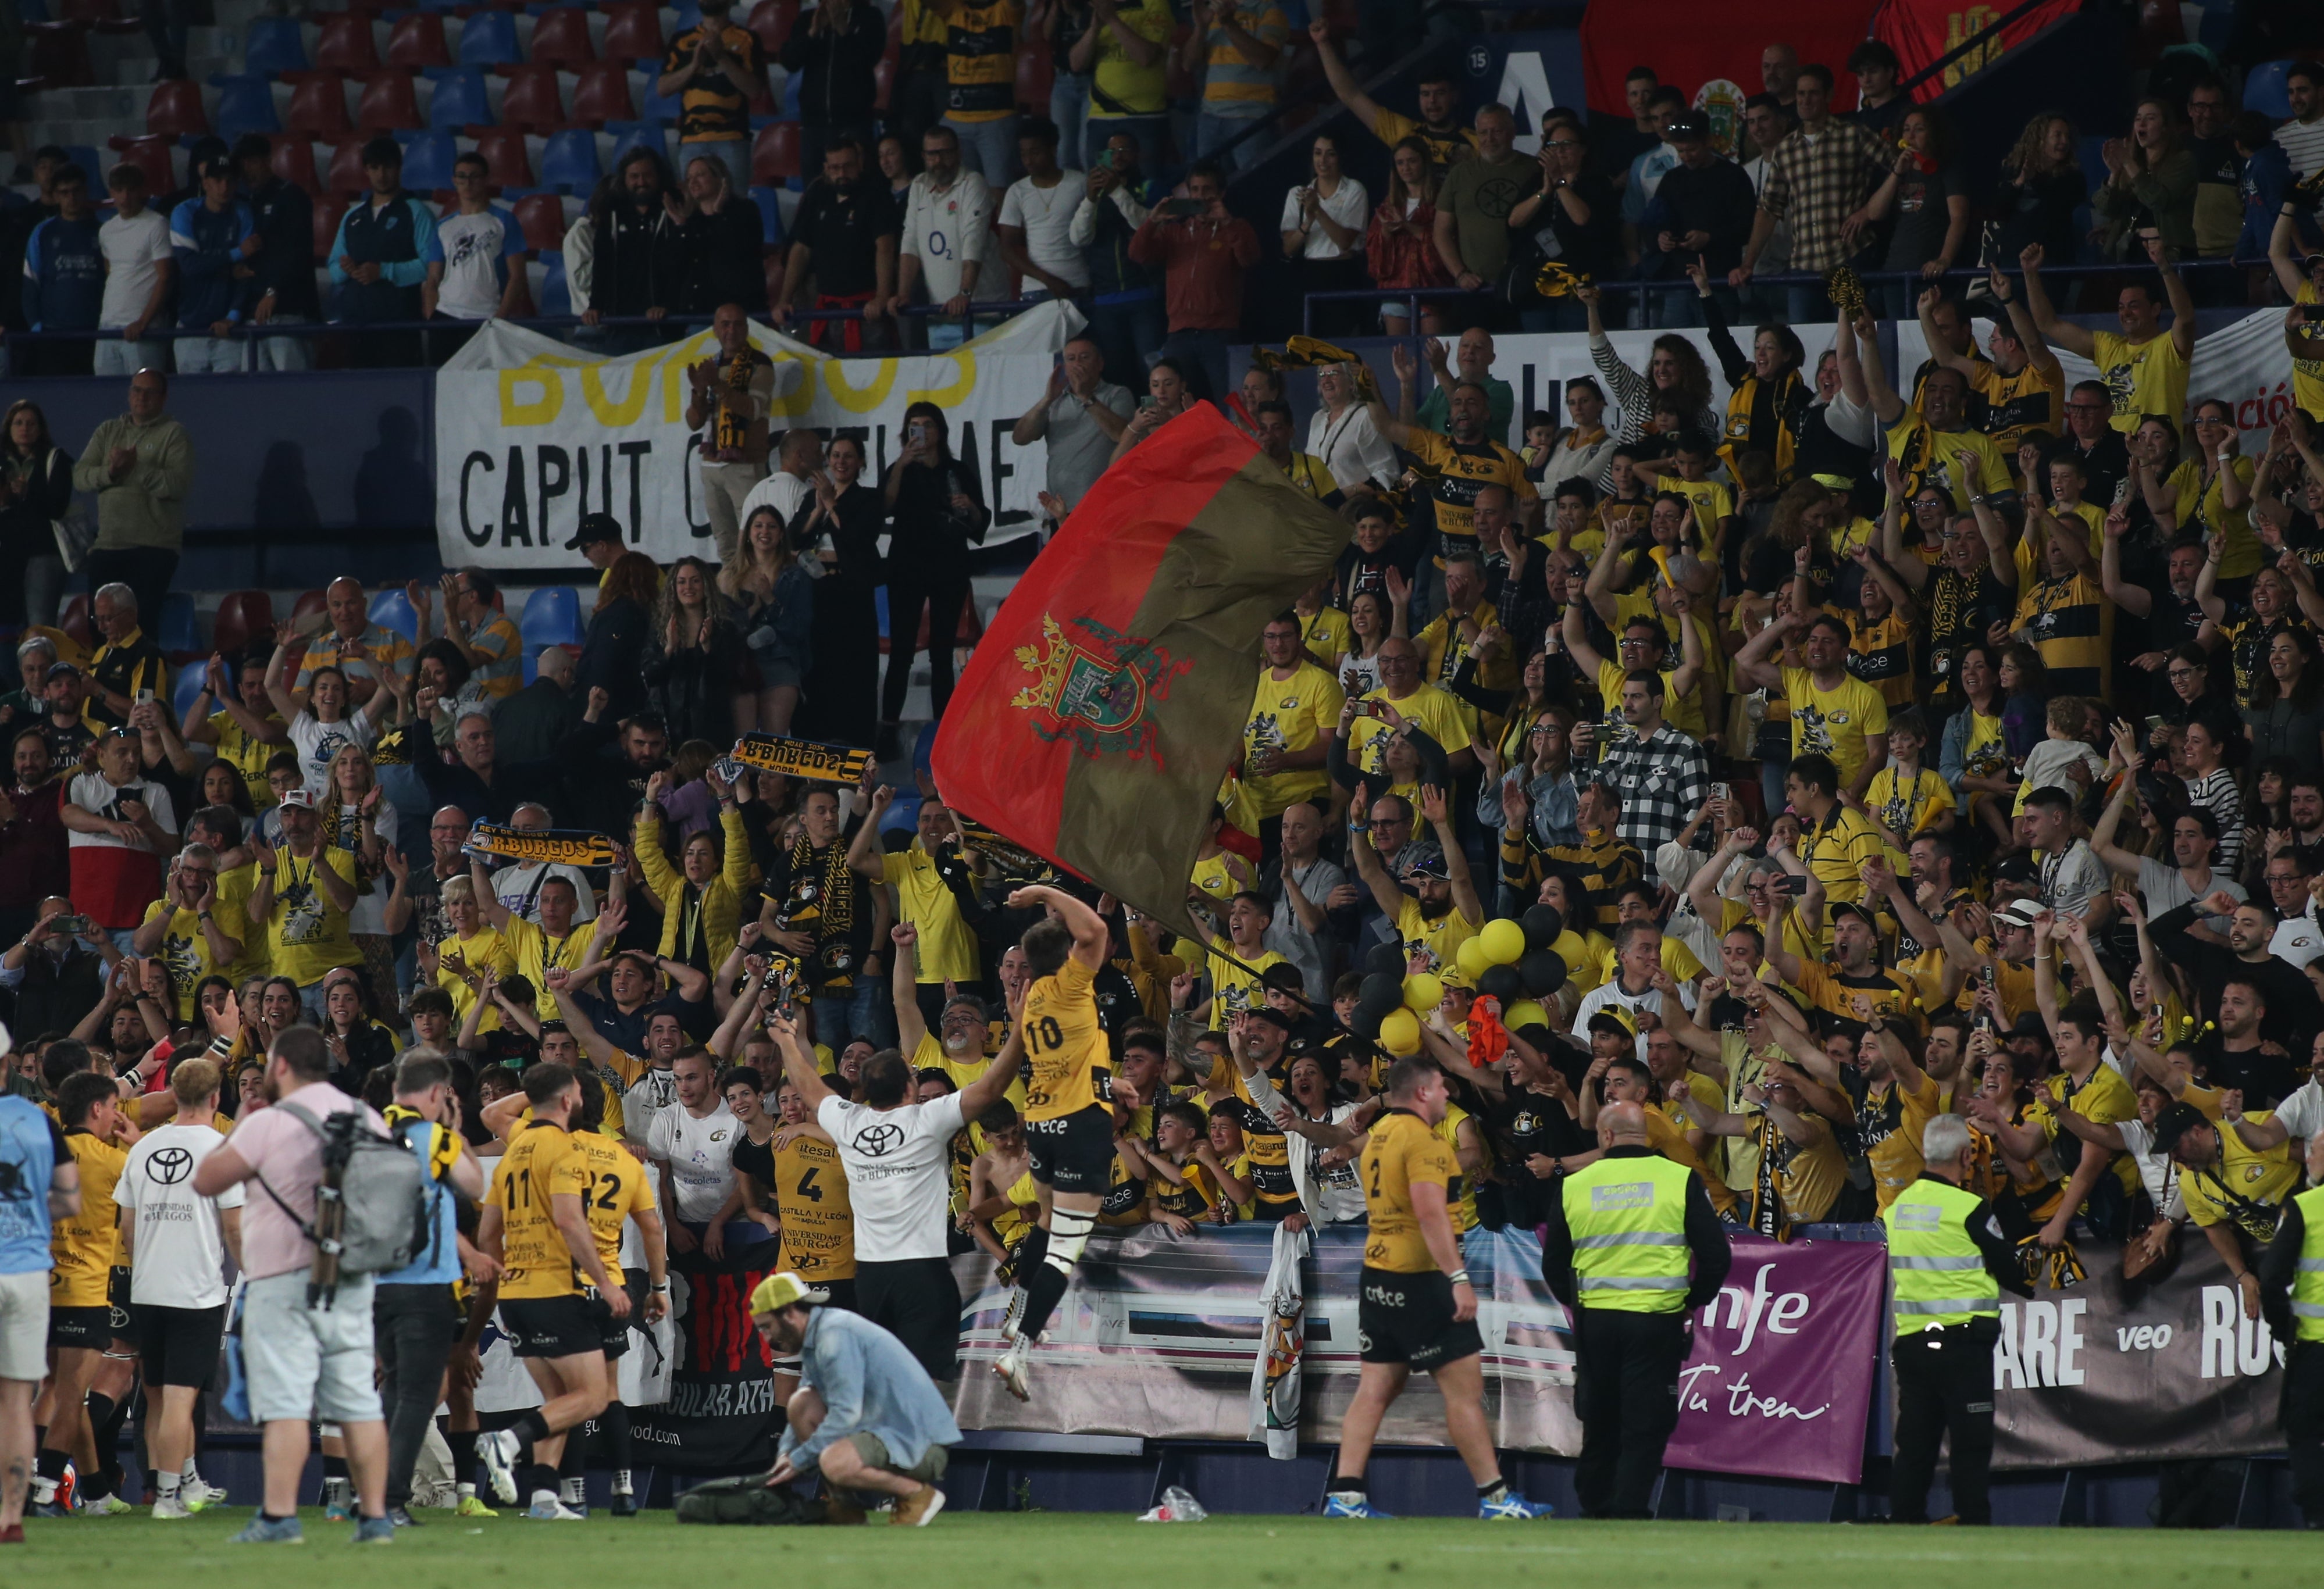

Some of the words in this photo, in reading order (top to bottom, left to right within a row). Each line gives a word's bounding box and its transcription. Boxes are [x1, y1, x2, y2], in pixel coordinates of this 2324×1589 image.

[1470, 52, 1487, 69] 15
[1026, 1016, 1064, 1055] 10
[799, 1143, 836, 1158] itesal
[799, 1153, 830, 1164] ventanas
[684, 1175, 722, 1185] Recoletas
[797, 1167, 823, 1202] 4
[1370, 1158, 1381, 1198] 2
[504, 1169, 530, 1211] 11
[815, 1211, 822, 1219] Y
[792, 1238, 841, 1249] BURGOS
[2116, 1323, 2173, 1352] veo
[1677, 1362, 1721, 1413] Tu
